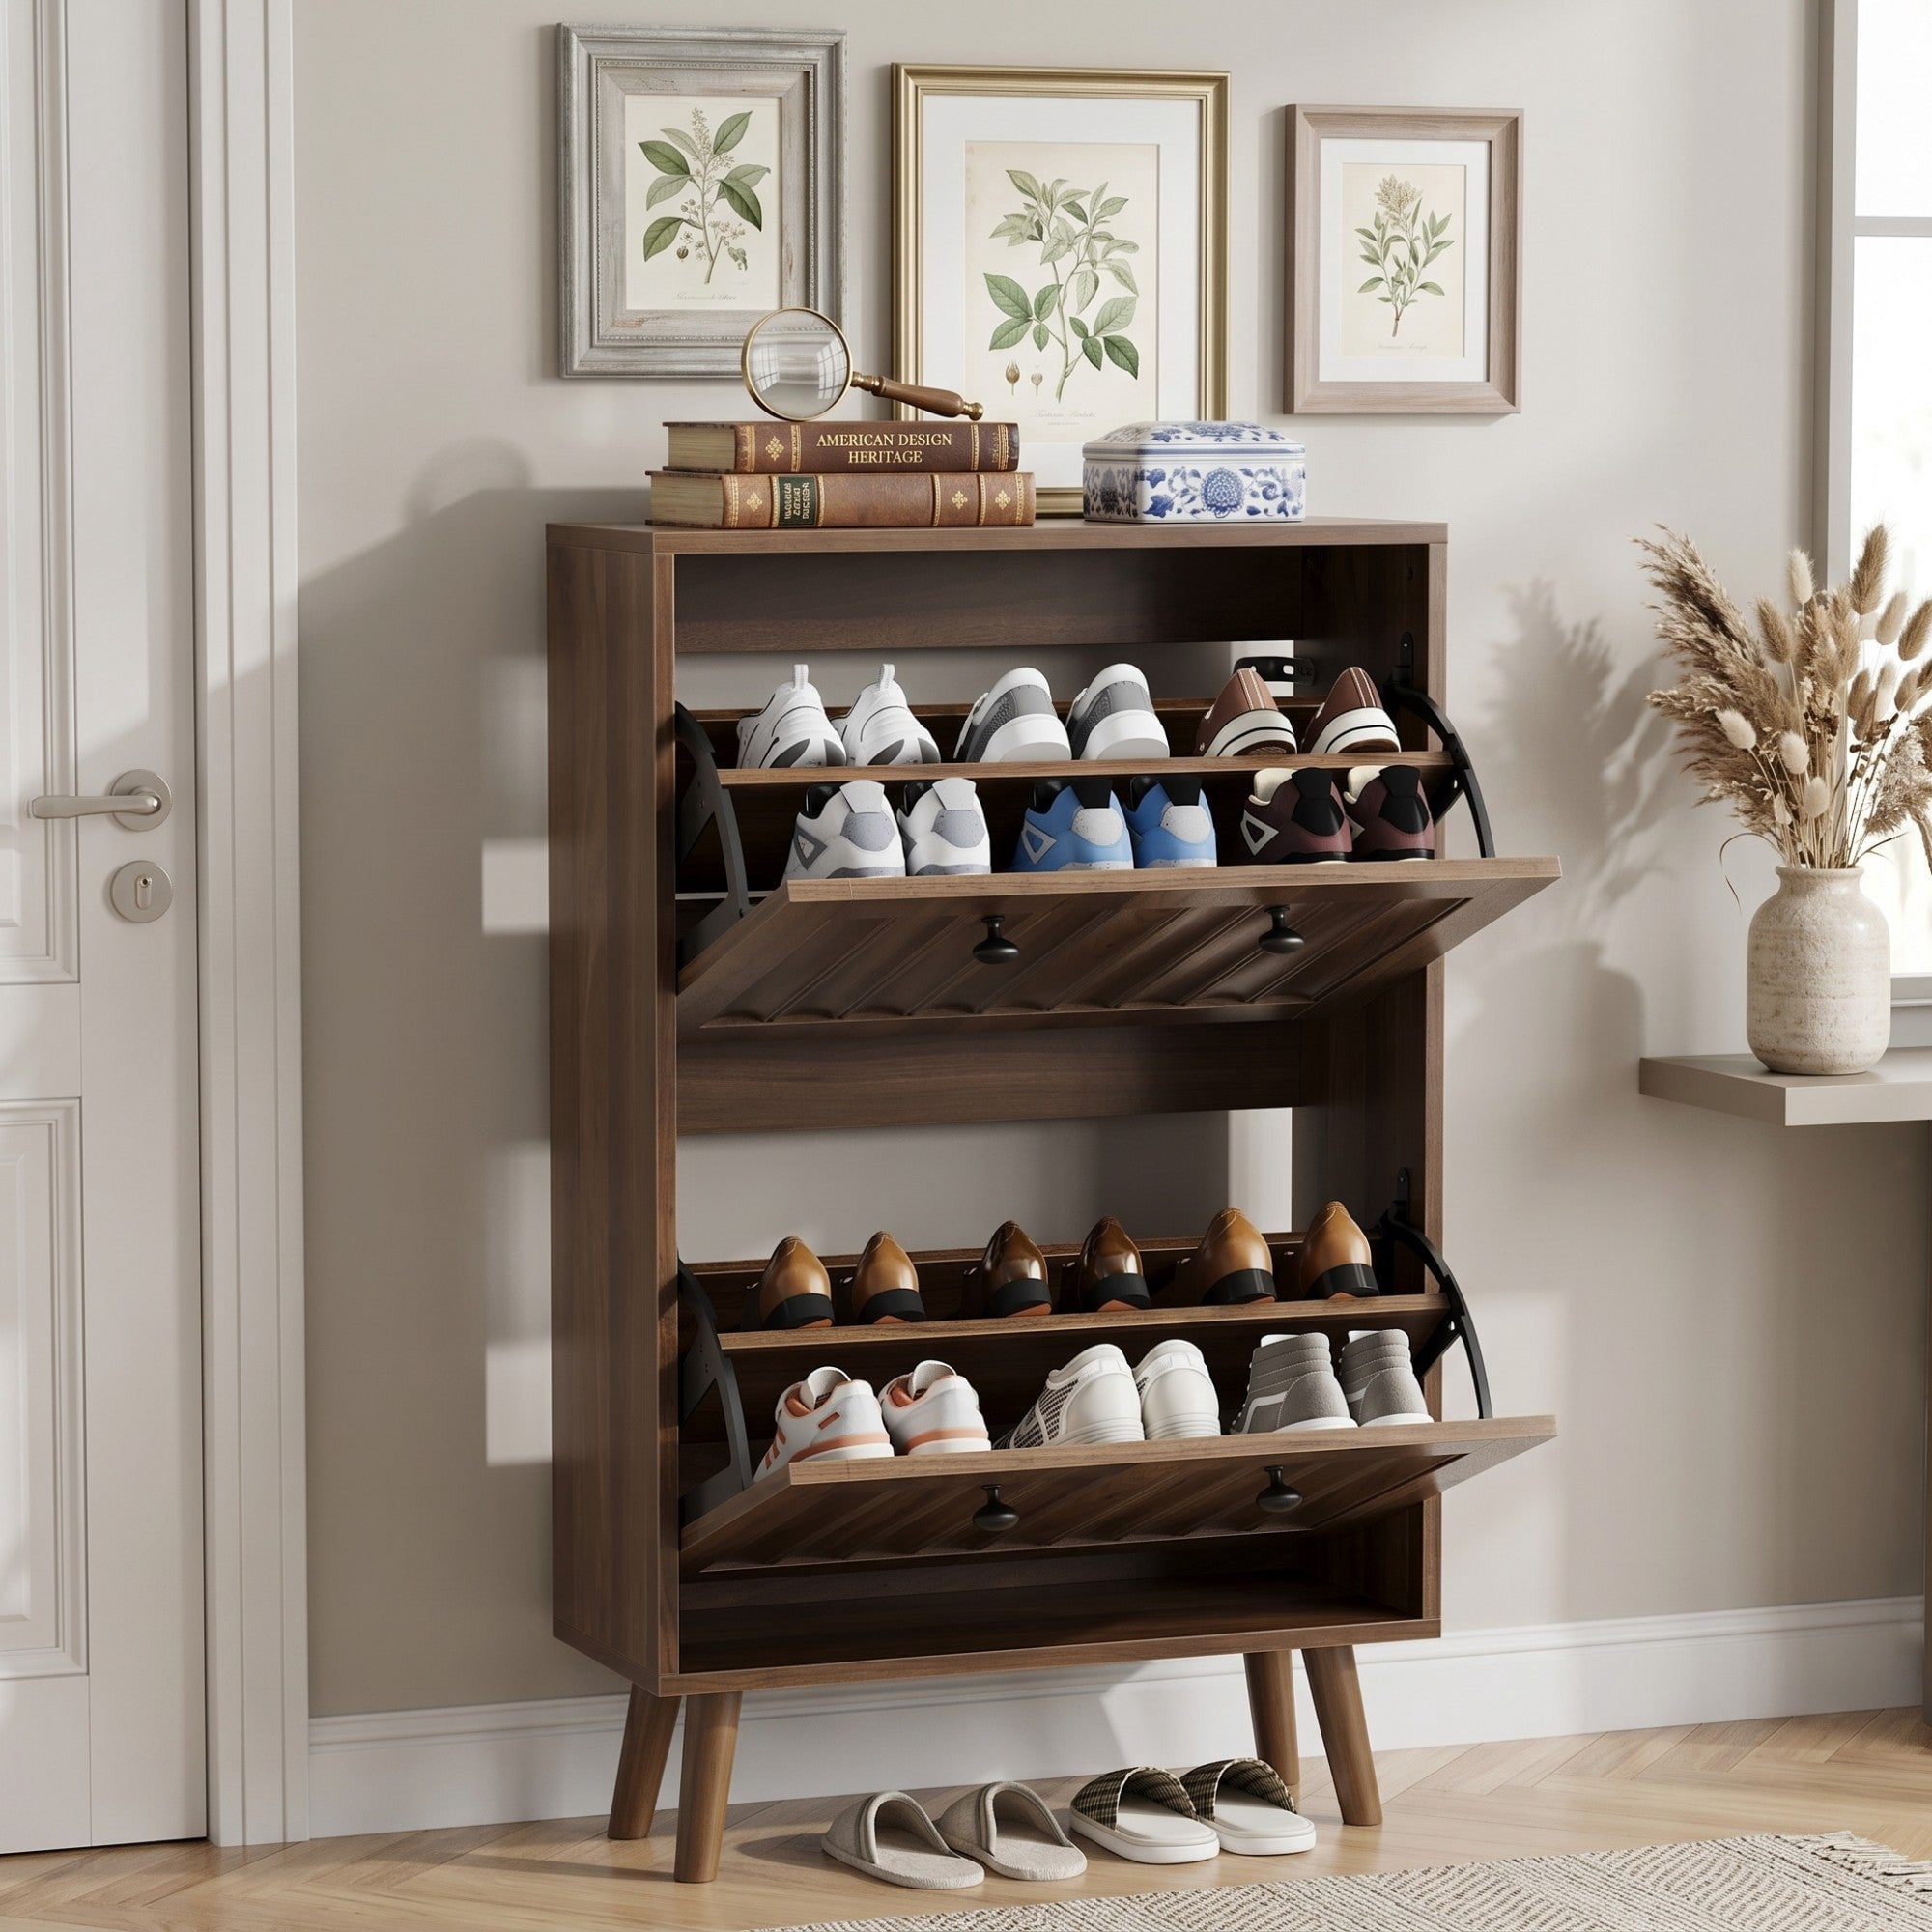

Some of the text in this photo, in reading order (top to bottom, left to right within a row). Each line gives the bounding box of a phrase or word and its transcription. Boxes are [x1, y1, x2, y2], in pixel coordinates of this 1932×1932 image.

[816, 433, 952, 447] AMERICAN DESIGN
[848, 450, 923, 464] HERITAGE
